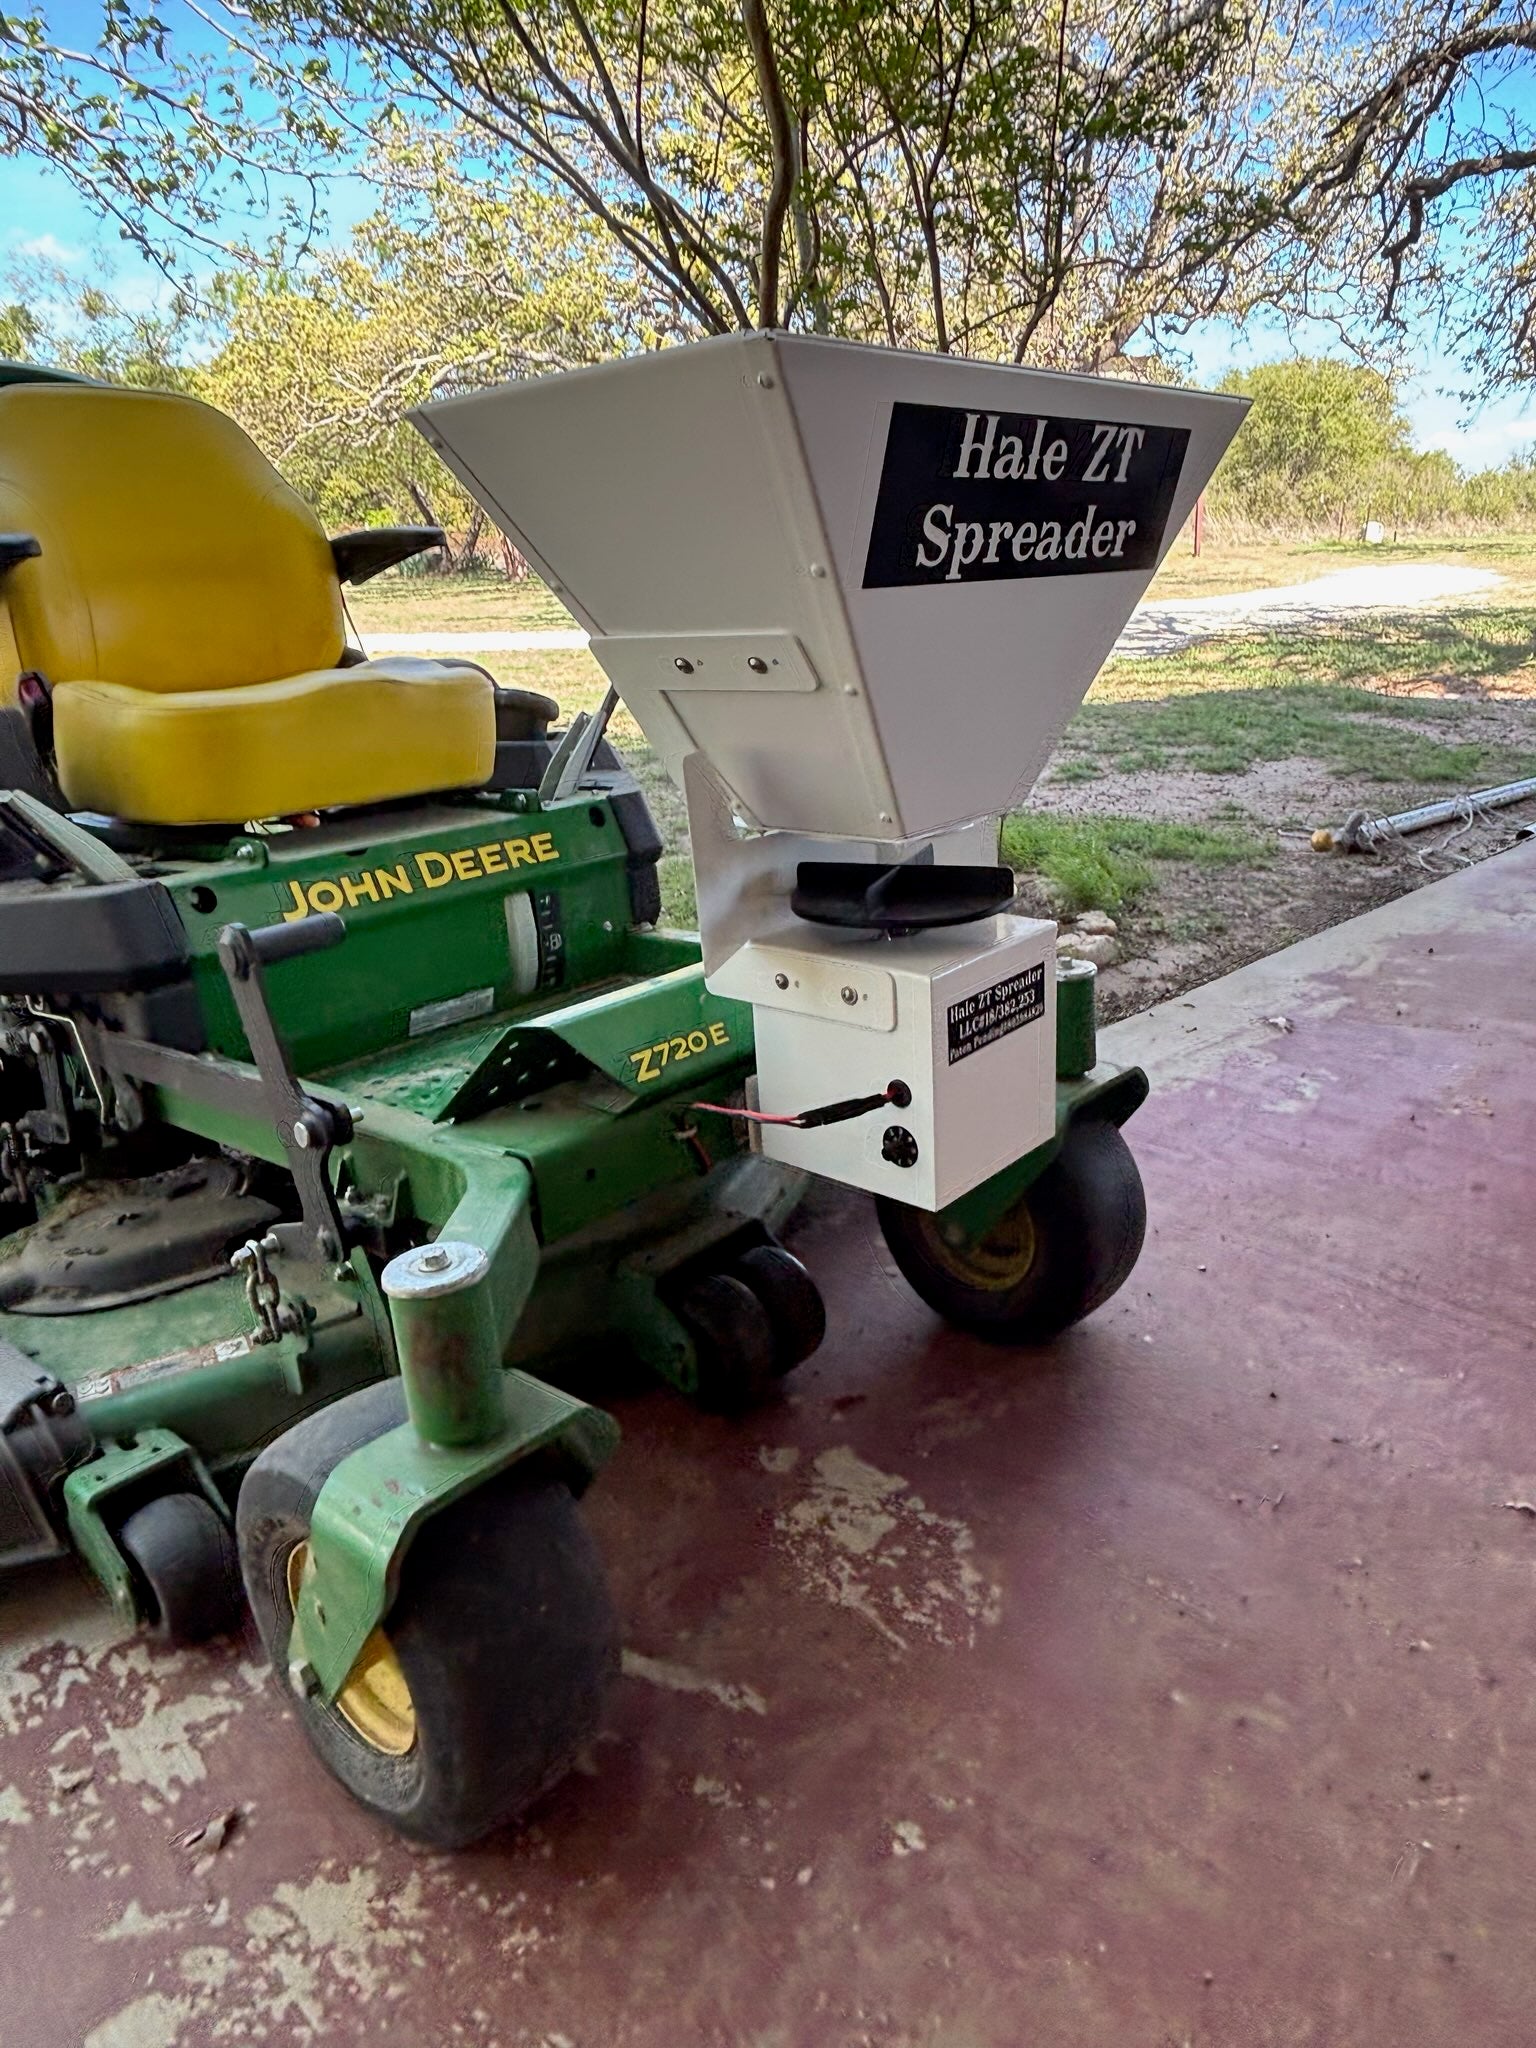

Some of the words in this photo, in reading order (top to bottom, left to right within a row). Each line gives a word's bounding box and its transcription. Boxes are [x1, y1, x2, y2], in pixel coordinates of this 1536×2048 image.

[953, 412, 1067, 482] Hale
[1082, 424, 1145, 483] ZT
[915, 503, 1136, 580] Spreader
[283, 864, 413, 923] JOHN
[414, 832, 560, 889] DEERE
[950, 1001, 976, 1024] Hale
[978, 990, 992, 1010] ZT
[994, 968, 1043, 1001] Spreader
